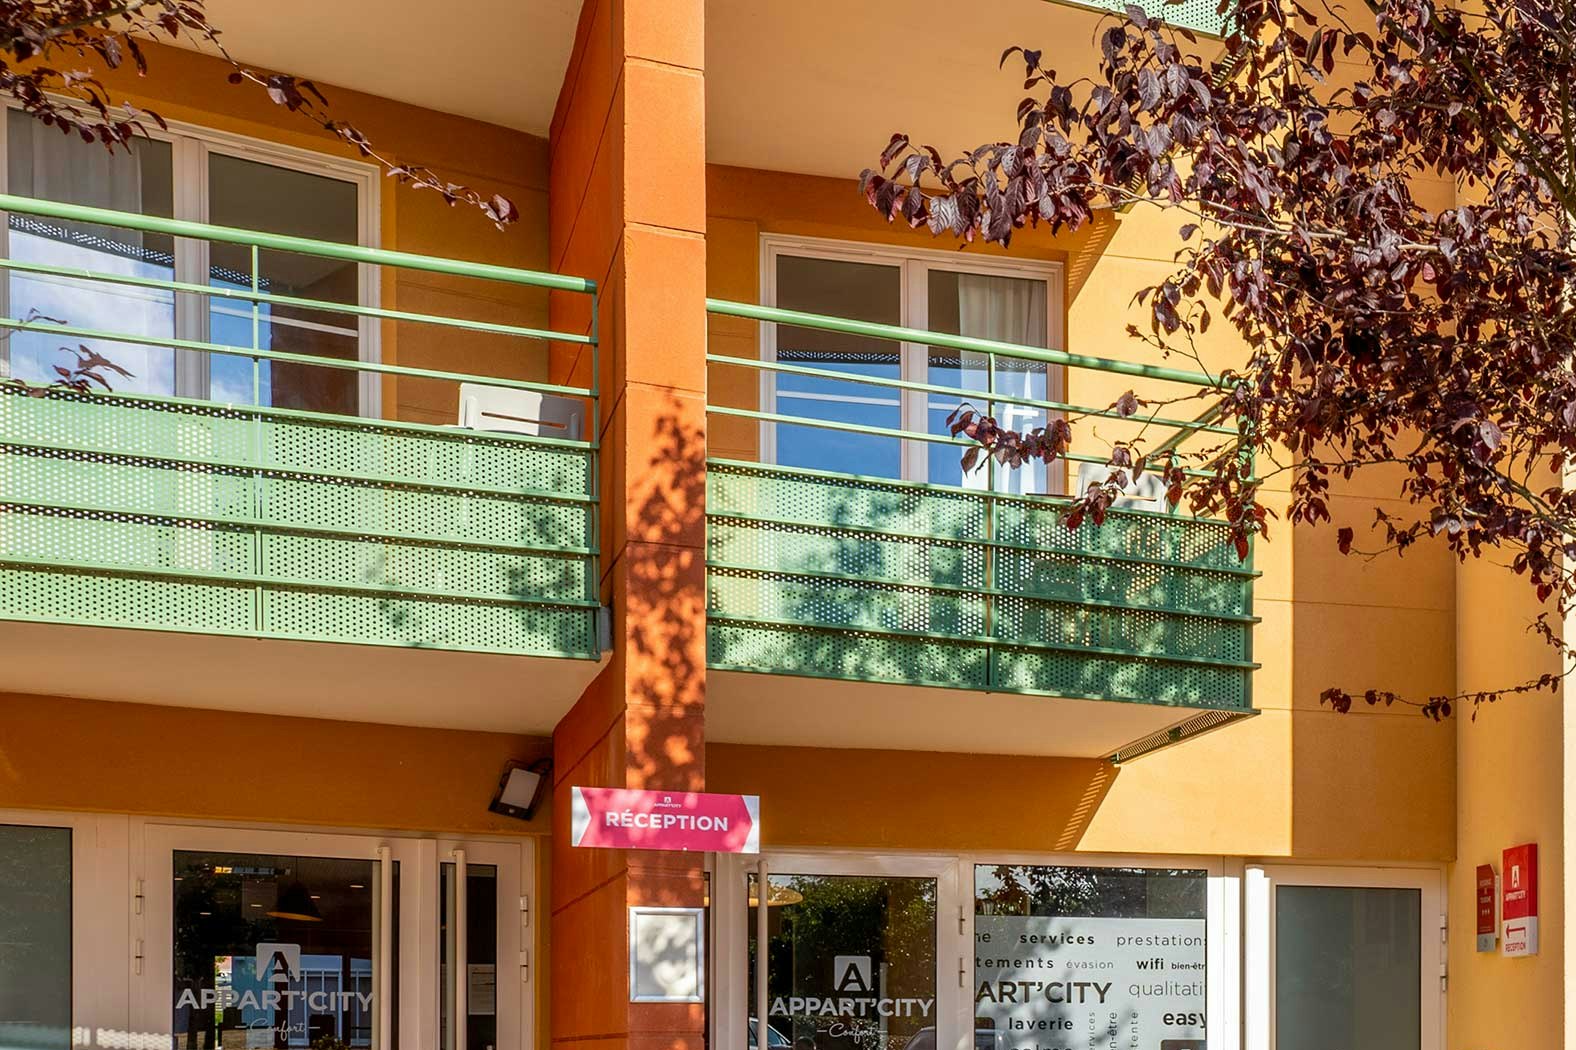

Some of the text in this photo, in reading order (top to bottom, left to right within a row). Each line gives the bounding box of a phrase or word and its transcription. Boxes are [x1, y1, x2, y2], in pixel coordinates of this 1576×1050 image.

[605, 809, 728, 832] RÉCEPTION
[1020, 933, 1095, 944] services
[976, 957, 1054, 969] tements
[1066, 960, 1114, 970] évasion
[1136, 958, 1164, 970] wifi
[175, 988, 374, 1012] APPART'CITY
[975, 981, 1113, 1003] ART'CITY
[769, 997, 934, 1017] APPART'CITY
[249, 1017, 305, 1042] Confort
[828, 1022, 876, 1044] Confort
[1008, 1017, 1074, 1031] laverie
